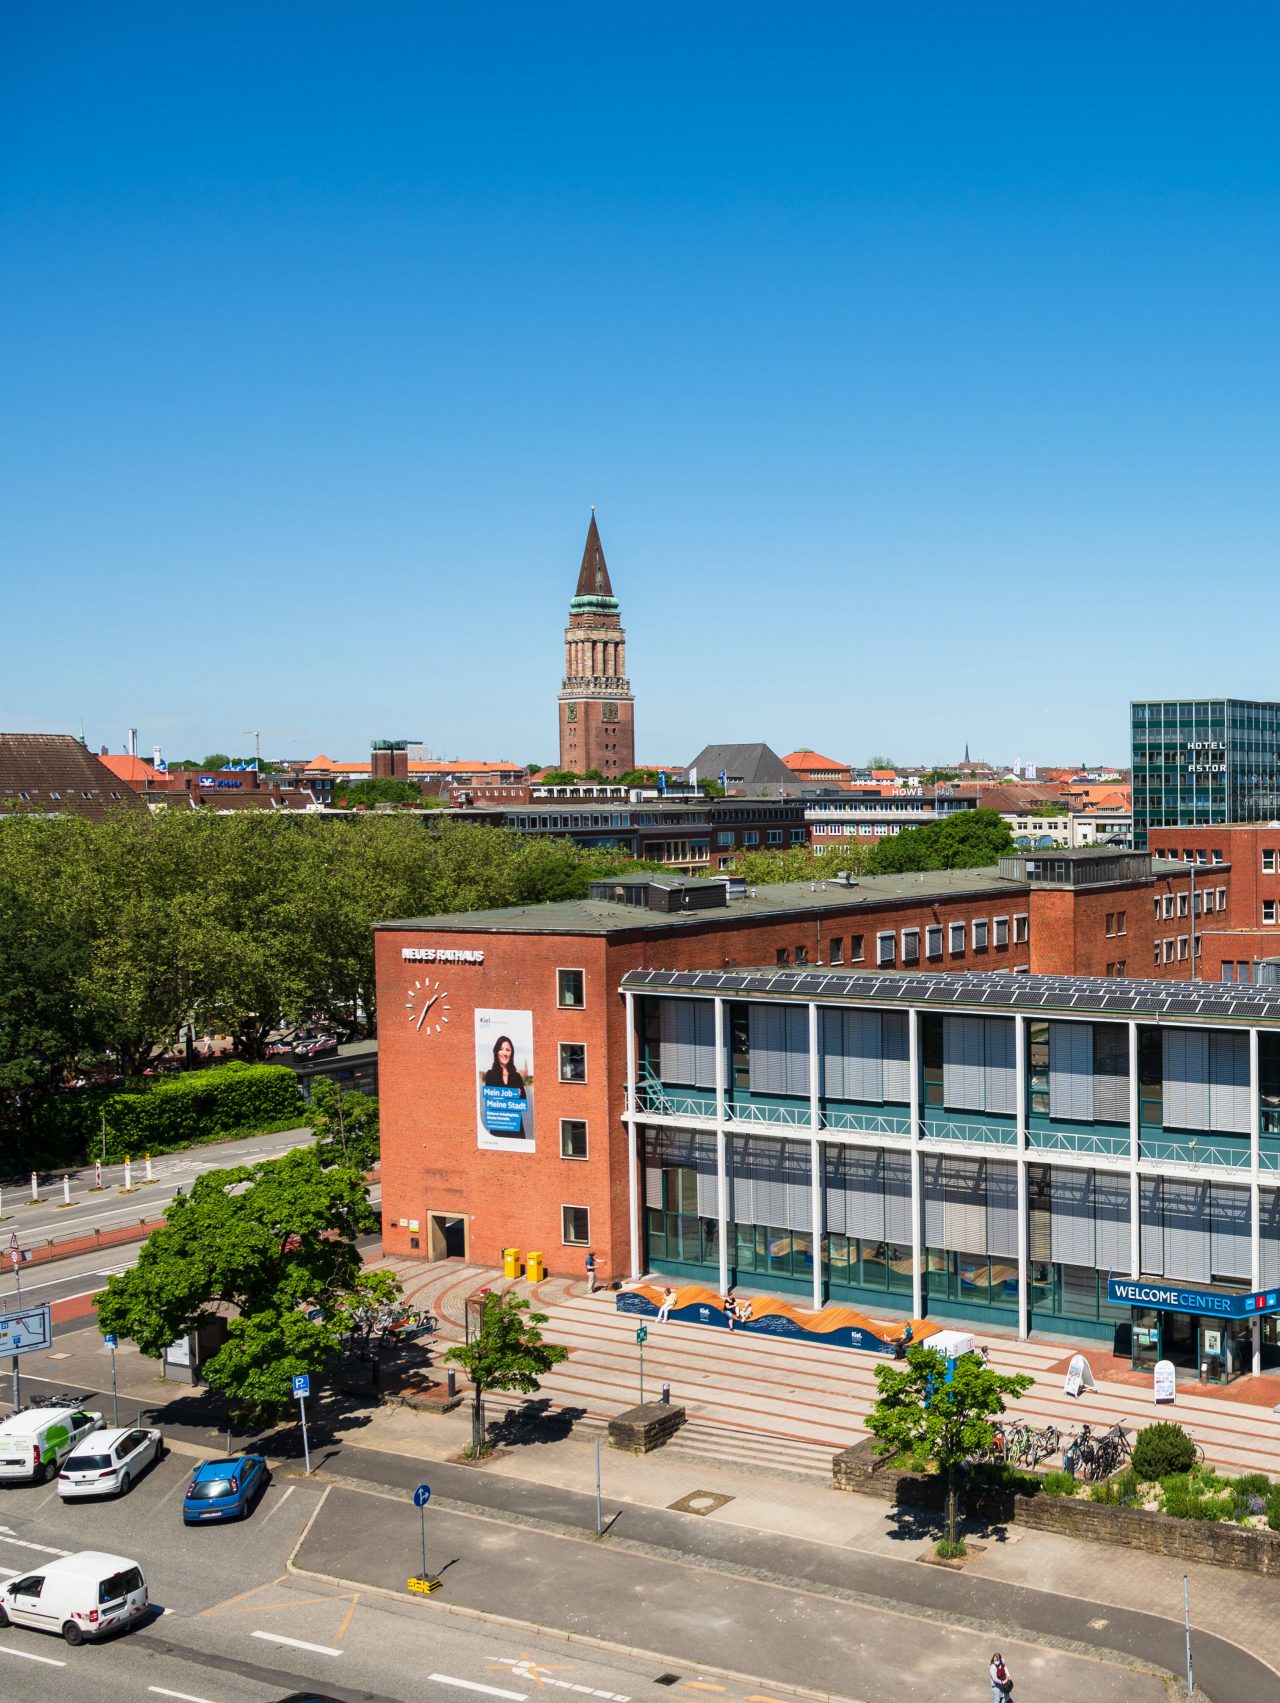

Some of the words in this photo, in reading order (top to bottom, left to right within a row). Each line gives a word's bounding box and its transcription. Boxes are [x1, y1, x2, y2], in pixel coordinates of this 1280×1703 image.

[1187, 742, 1226, 750] HOTEL
[1188, 764, 1227, 772] ASTOR
[892, 788, 923, 796] HOWE
[402, 948, 436, 960] NEUES
[436, 949, 485, 962] RATHAUS
[501, 1089, 513, 1097] Job
[486, 1100, 507, 1109] Meine
[508, 1101, 526, 1110] Stadt
[1115, 1285, 1179, 1305] WELCOME
[1179, 1293, 1231, 1312] CENTER
[296, 1378, 304, 1388] P
